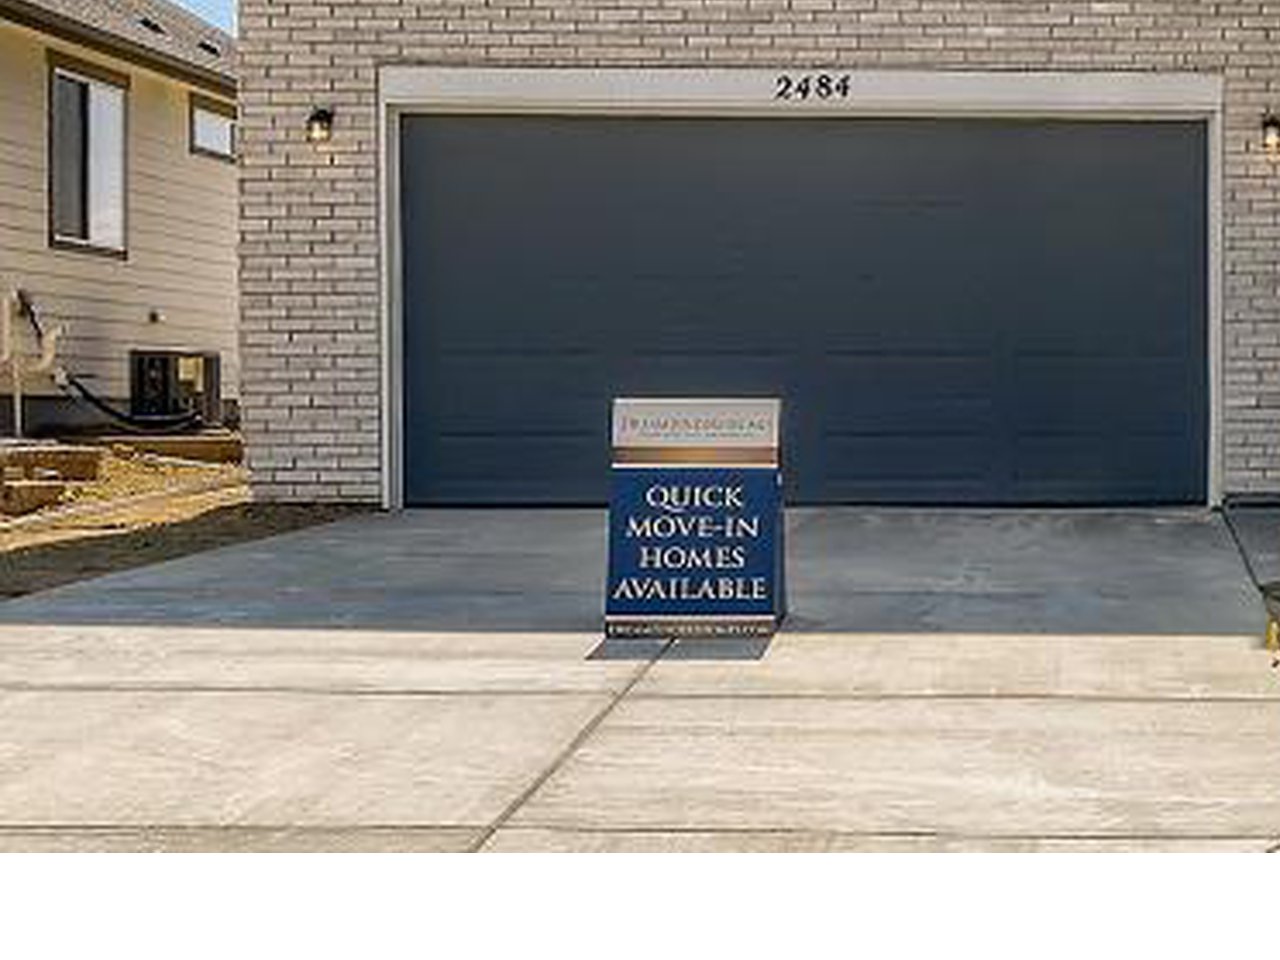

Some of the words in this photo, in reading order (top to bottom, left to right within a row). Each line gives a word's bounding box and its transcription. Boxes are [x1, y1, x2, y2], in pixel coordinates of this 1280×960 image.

[773, 74, 851, 100] 2484
[645, 484, 744, 513] QUICK
[625, 517, 759, 539] MOVE-IN
[638, 546, 746, 569] HOMES
[612, 577, 768, 601] AVAILABLE
